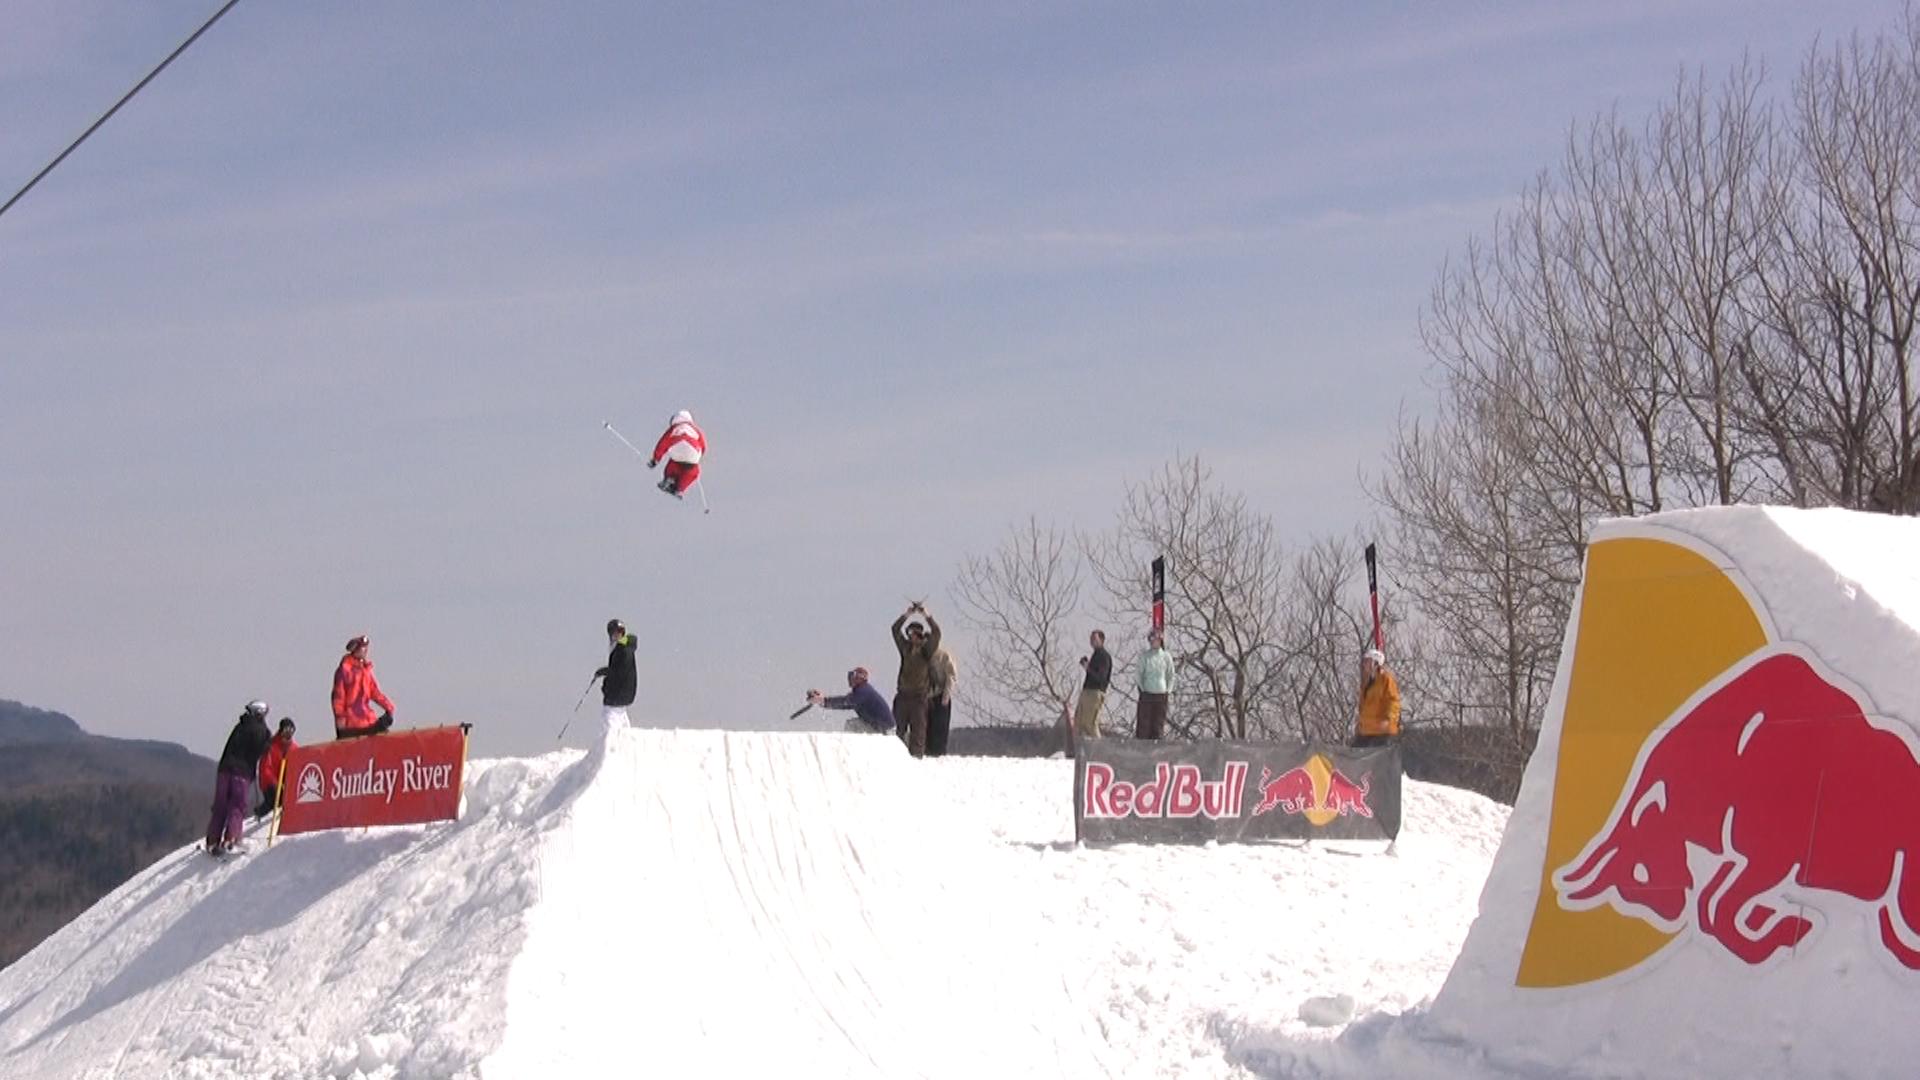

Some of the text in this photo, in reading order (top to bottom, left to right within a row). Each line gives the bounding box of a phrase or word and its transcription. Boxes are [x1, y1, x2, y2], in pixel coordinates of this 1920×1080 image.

[331, 756, 452, 804] Sunday River
[1084, 762, 1248, 819] Red Bull
